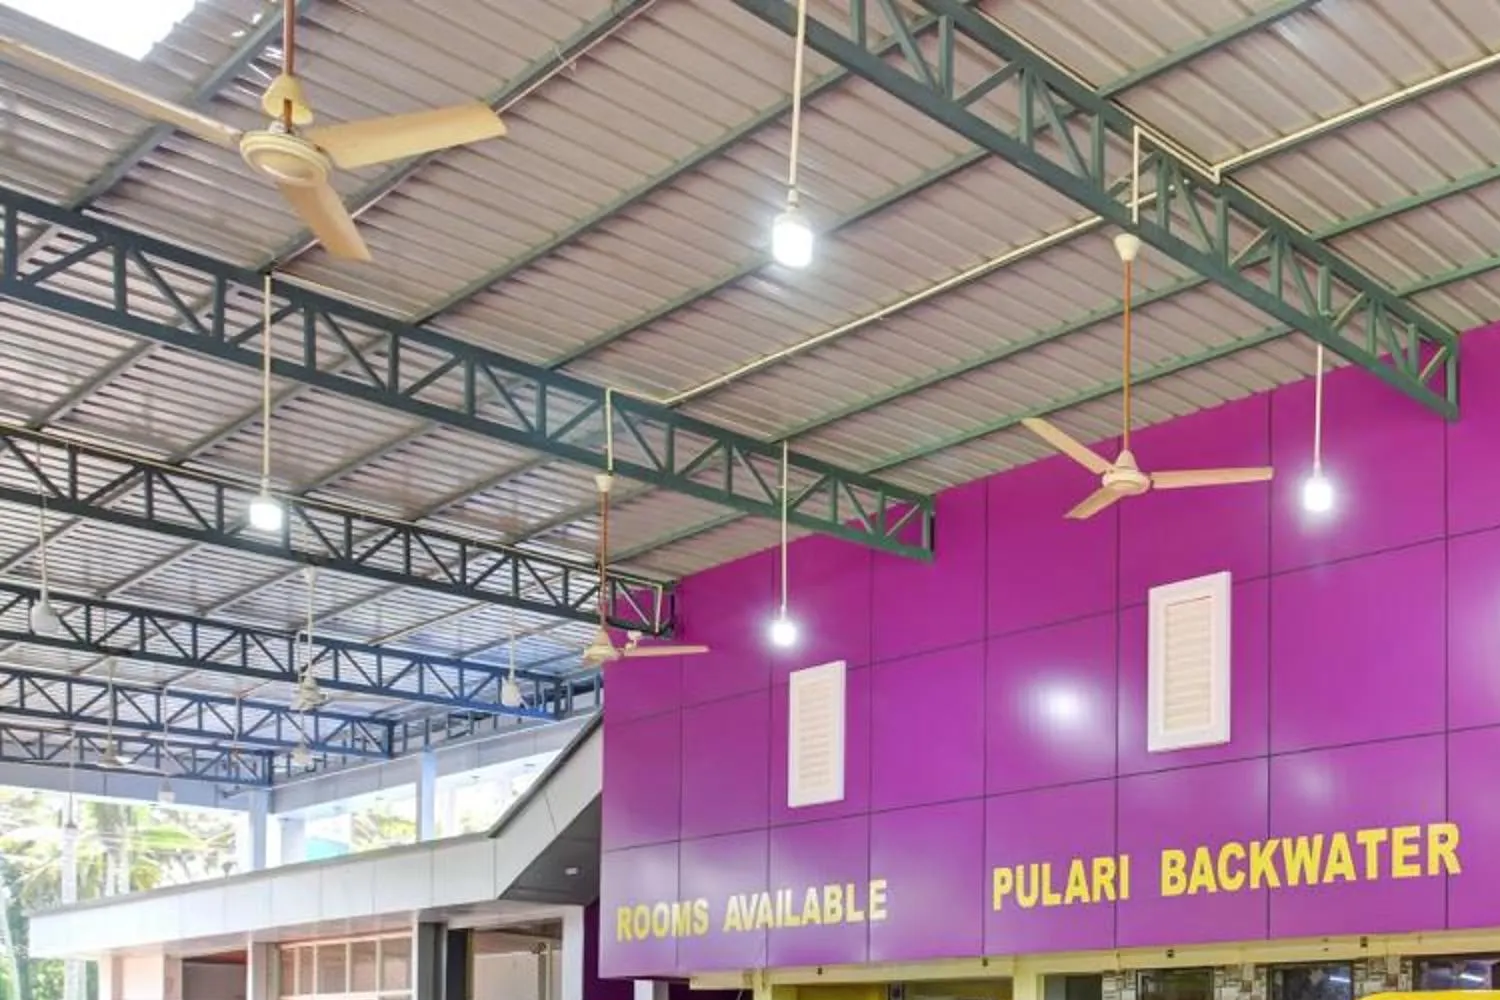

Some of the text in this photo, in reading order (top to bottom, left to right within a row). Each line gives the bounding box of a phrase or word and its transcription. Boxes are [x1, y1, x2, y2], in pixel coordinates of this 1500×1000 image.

[992, 822, 1461, 910] PULARI BACKWATER
[616, 878, 887, 942] ROOMS AVAILABLE
